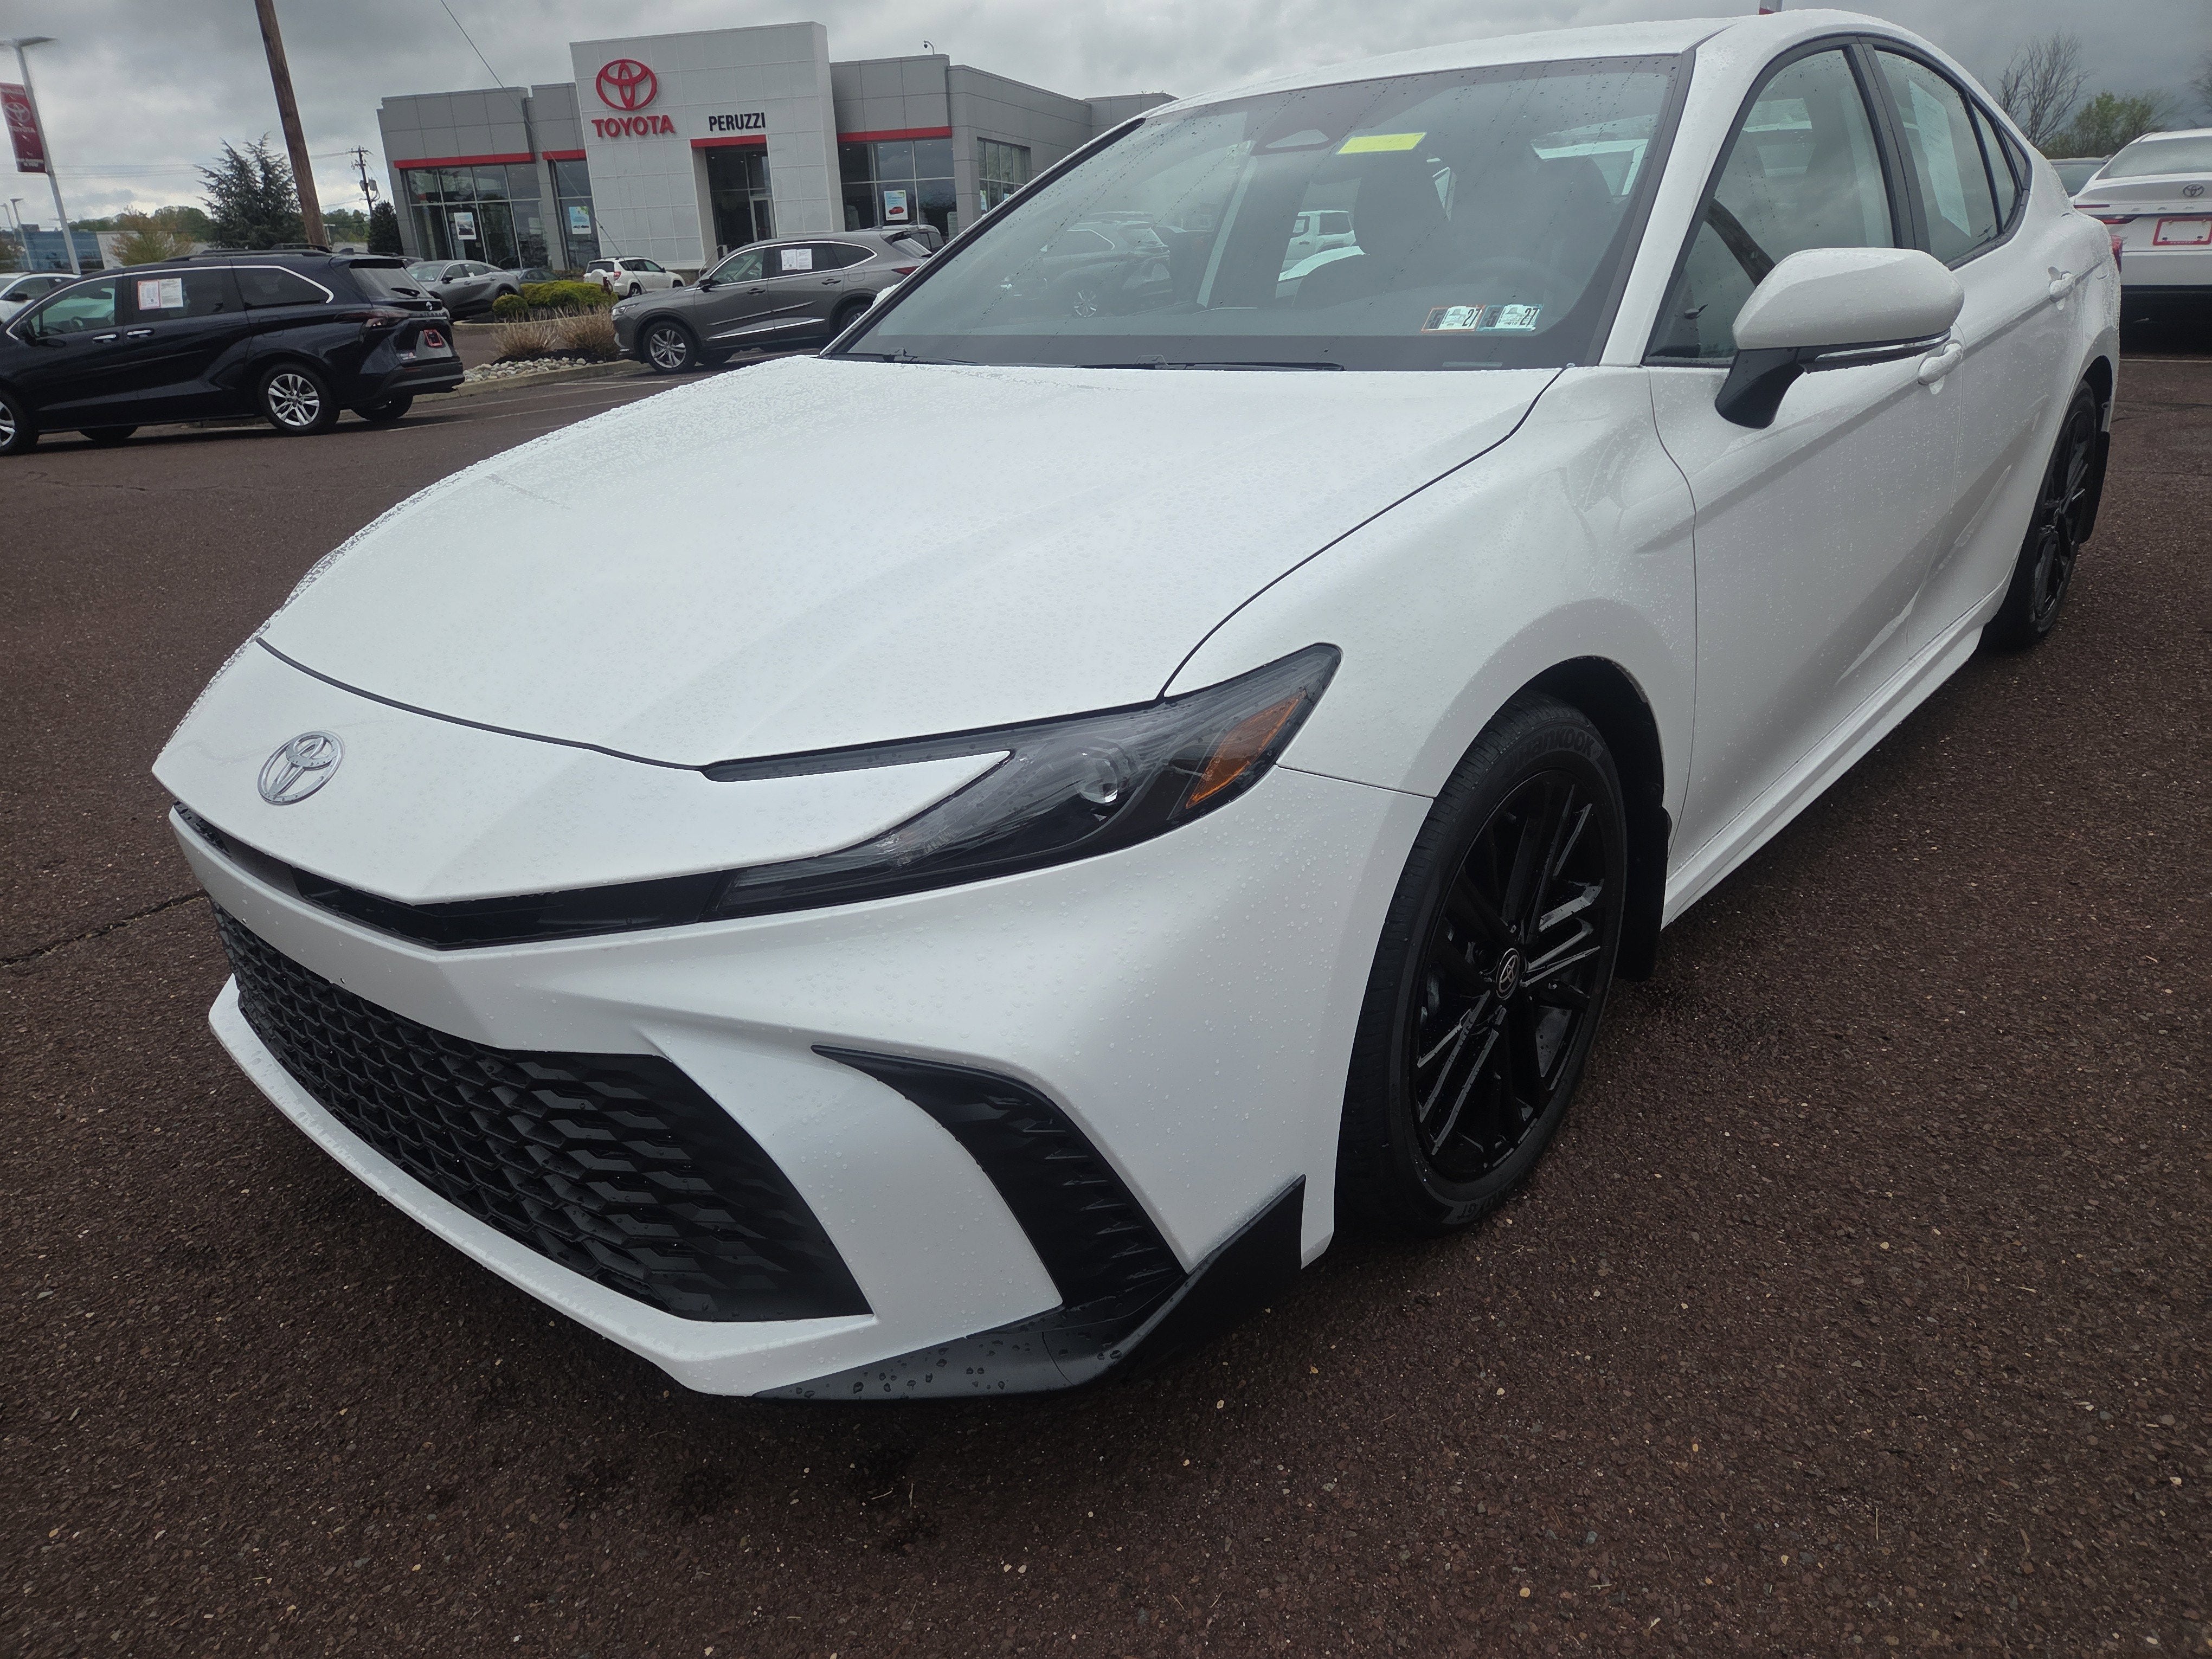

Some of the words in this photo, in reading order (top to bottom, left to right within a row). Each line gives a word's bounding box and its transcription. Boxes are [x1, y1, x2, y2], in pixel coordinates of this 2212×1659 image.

[591, 114, 675, 138] TOYOTA
[708, 112, 766, 132] PERUZZI
[1462, 308, 1482, 328] 27
[1519, 307, 1539, 327] 27
